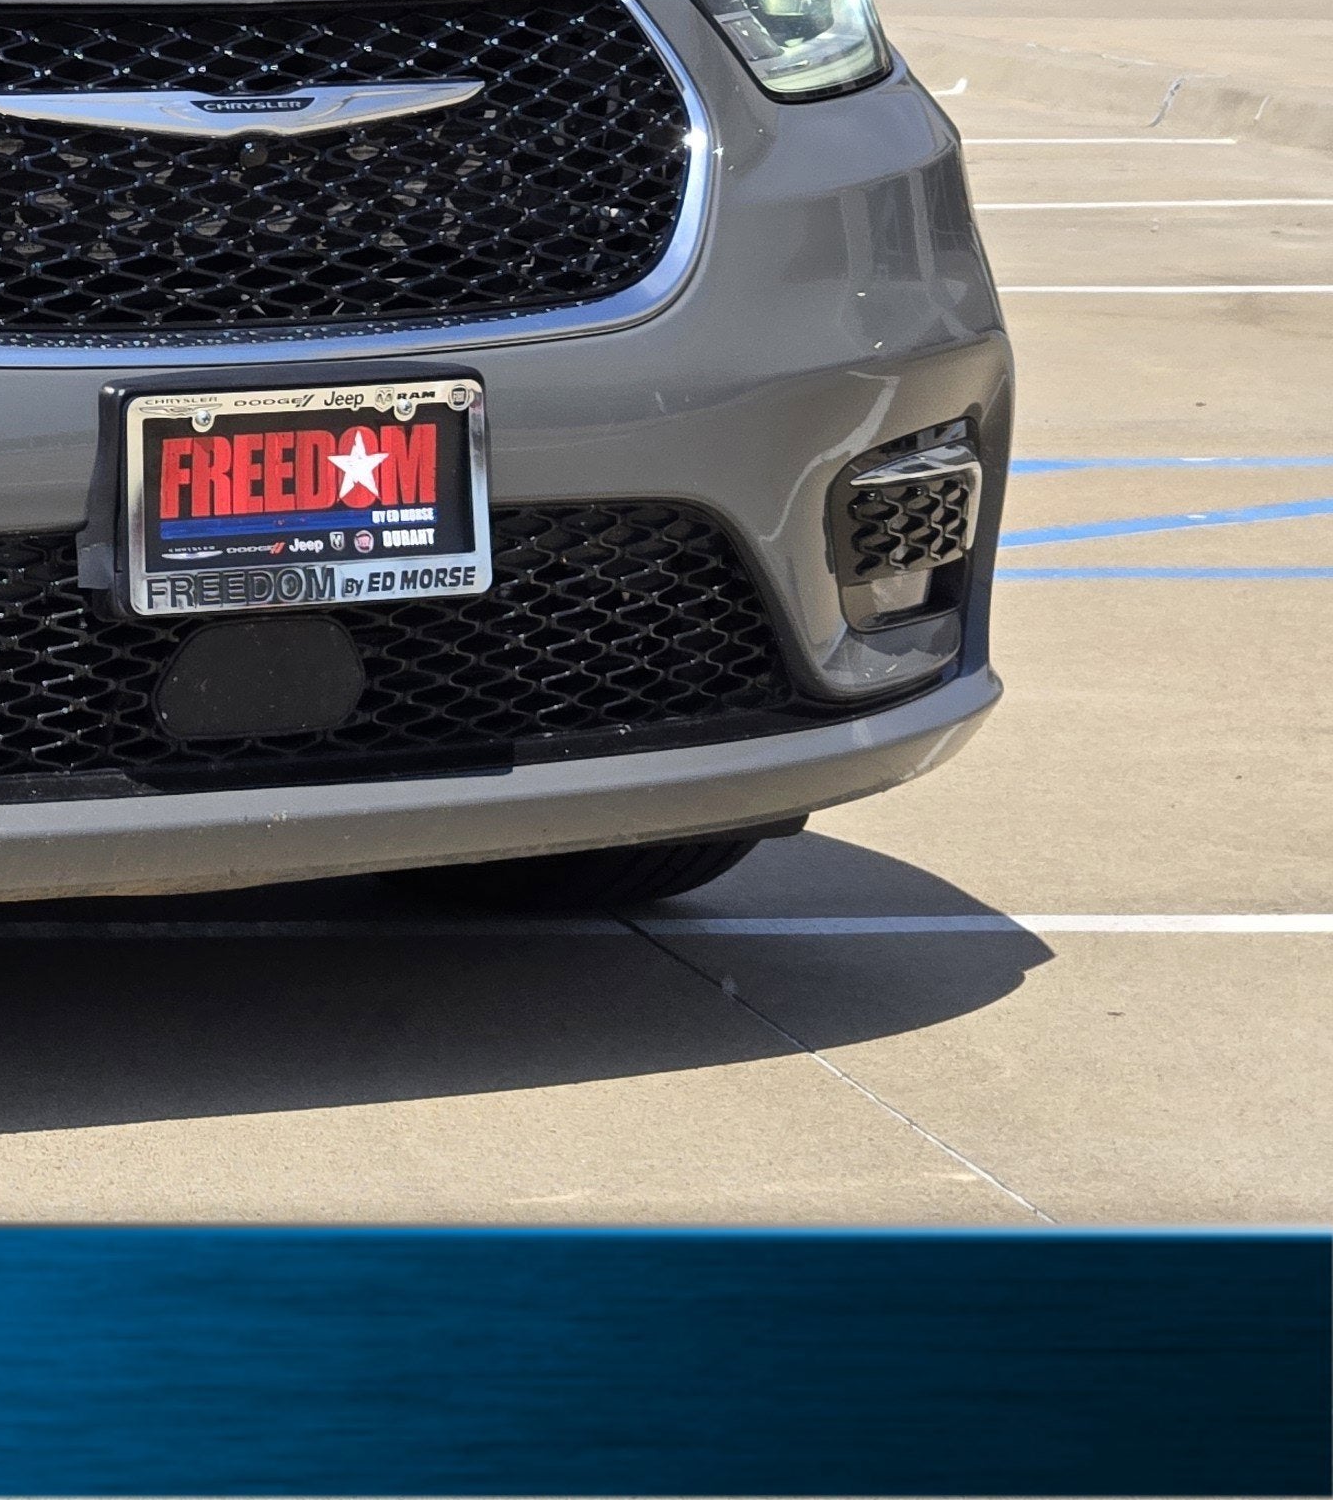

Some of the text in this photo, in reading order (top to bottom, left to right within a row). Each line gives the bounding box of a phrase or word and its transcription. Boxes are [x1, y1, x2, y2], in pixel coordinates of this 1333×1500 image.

[203, 100, 302, 112] CHRYSLER
[144, 391, 436, 408] CHRYSLER DODGE Jeep RAM
[160, 423, 437, 519] FREEDOM
[289, 538, 324, 553] Jeep
[382, 528, 435, 547] DURANT
[145, 565, 476, 610] FREEDOM By ED MORSE
